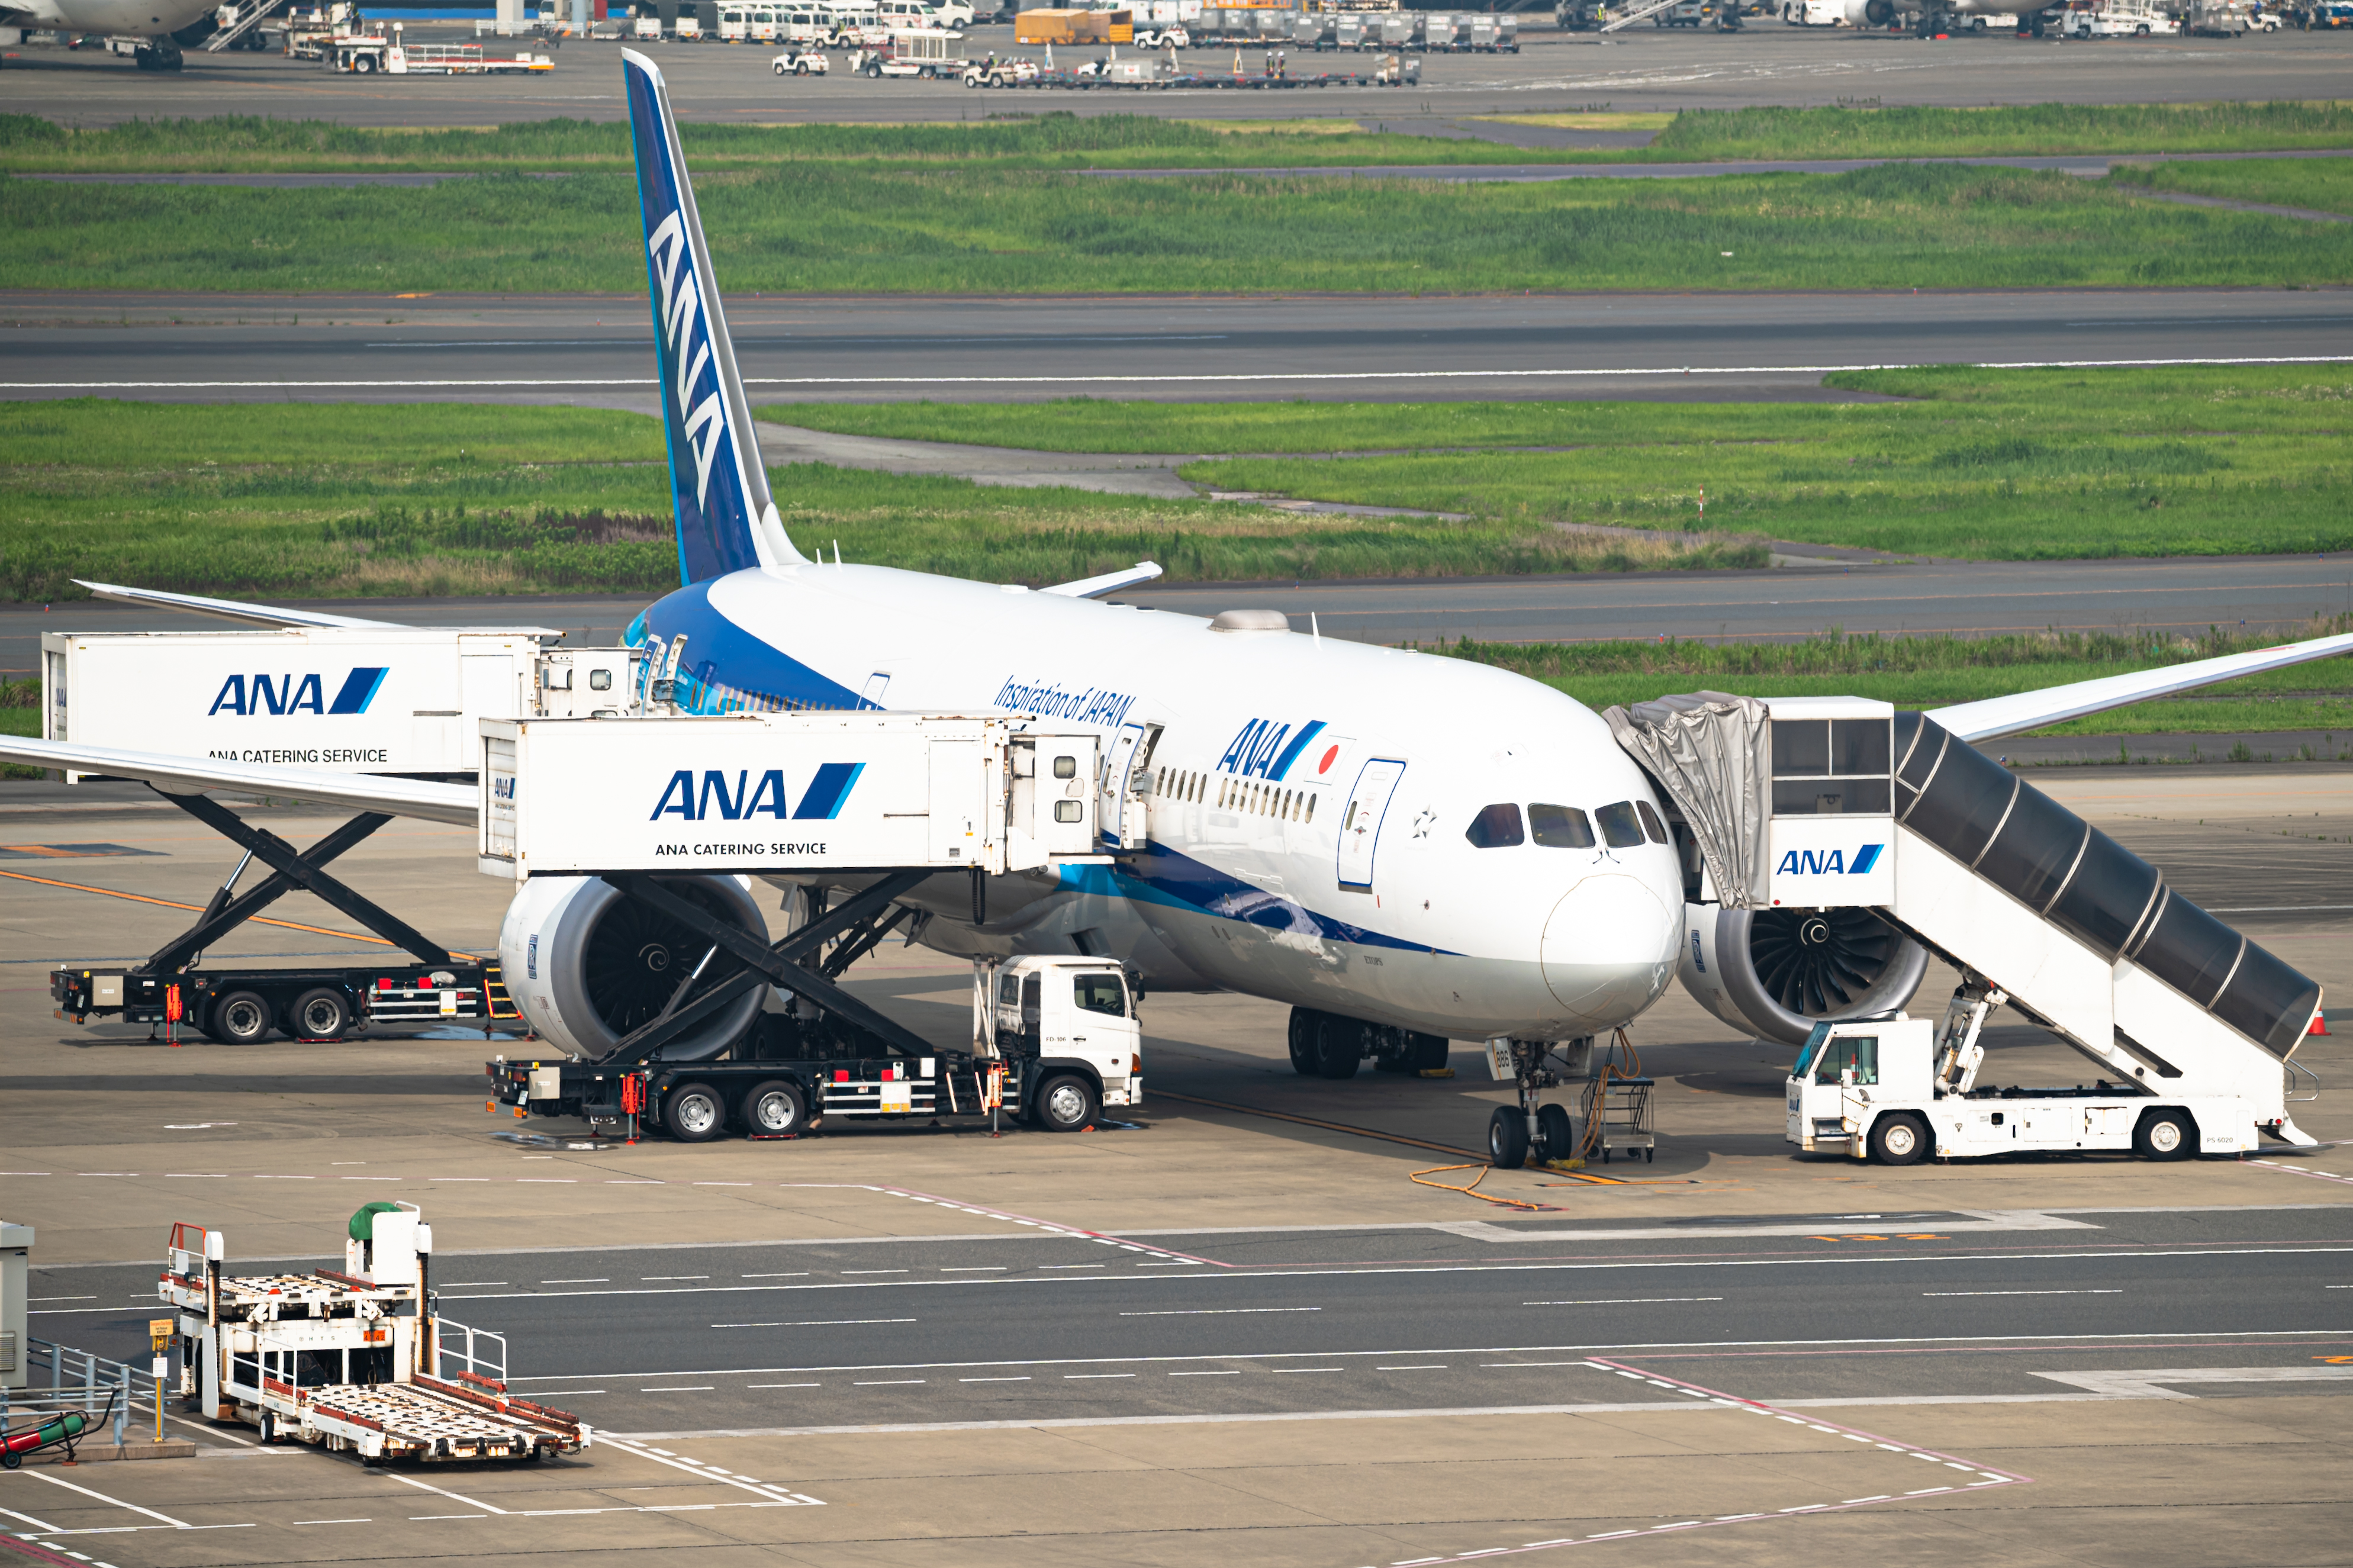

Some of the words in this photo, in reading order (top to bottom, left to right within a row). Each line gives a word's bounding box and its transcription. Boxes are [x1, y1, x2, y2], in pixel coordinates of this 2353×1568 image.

[649, 209, 724, 516] ANA
[208, 674, 323, 716] ANA
[994, 675, 1069, 717] Inspiration
[1064, 687, 1094, 719] of
[1078, 690, 1137, 727] JAPAN
[243, 749, 318, 763] CATERING
[323, 749, 387, 762] SERVICE
[1216, 718, 1291, 778] ANA
[494, 778, 508, 799] ANA
[649, 769, 787, 820] ANA
[655, 843, 688, 855] ANA
[694, 843, 765, 855] CATERING
[771, 842, 826, 855] SERVICE
[1776, 849, 1844, 875] ANA
[1363, 955, 1383, 966] ETOPS
[1496, 1050, 1509, 1068] 886
